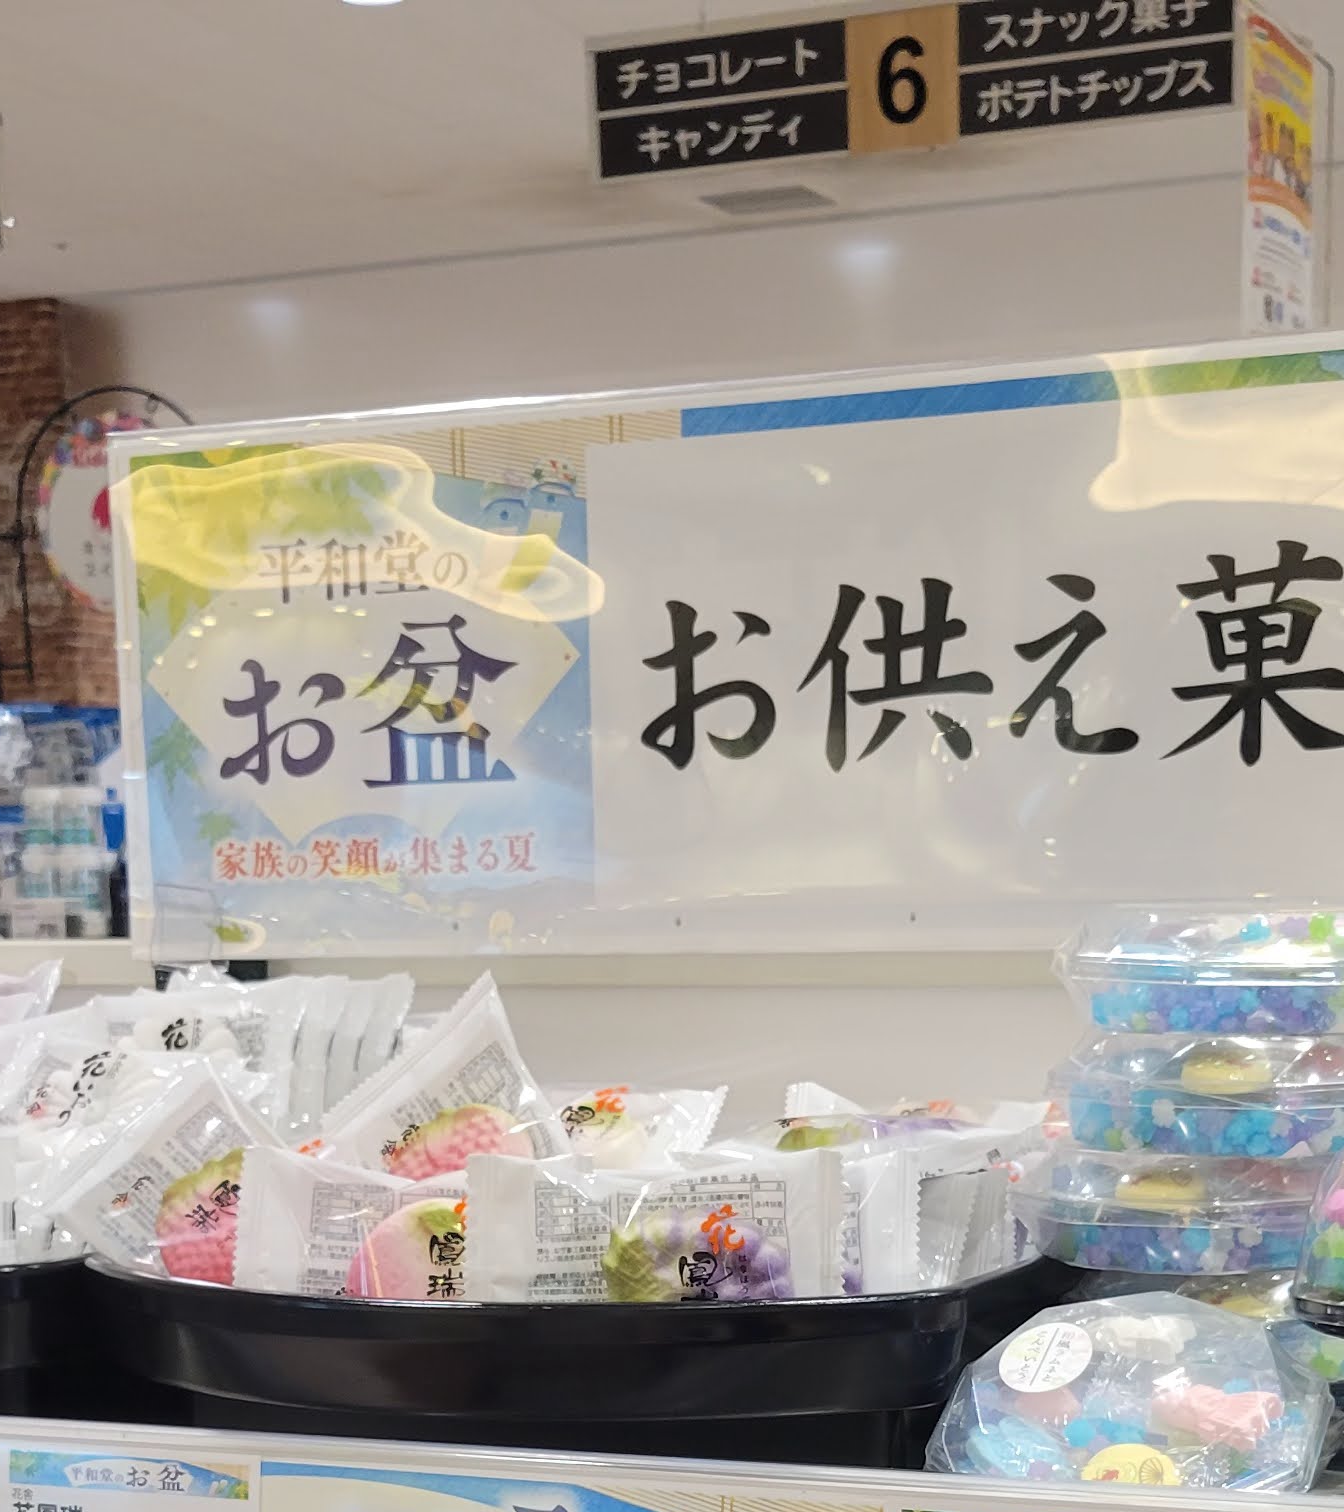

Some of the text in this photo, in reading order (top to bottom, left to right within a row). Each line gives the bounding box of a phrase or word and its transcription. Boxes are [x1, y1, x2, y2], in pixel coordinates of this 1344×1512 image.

[984, 0, 1217, 51] スナック菓子
[617, 39, 818, 99] チョコレート
[877, 36, 927, 124] 6
[977, 58, 1214, 122] ポテトチップス
[637, 113, 801, 162] キャンディ
[258, 530, 469, 603] 平和堂の
[219, 614, 519, 788] お盆
[215, 831, 538, 880] 家族の笑顔が集まる夏
[162, 1017, 188, 1051] 花
[72, 1464, 186, 1493] 平和堂のお盆
